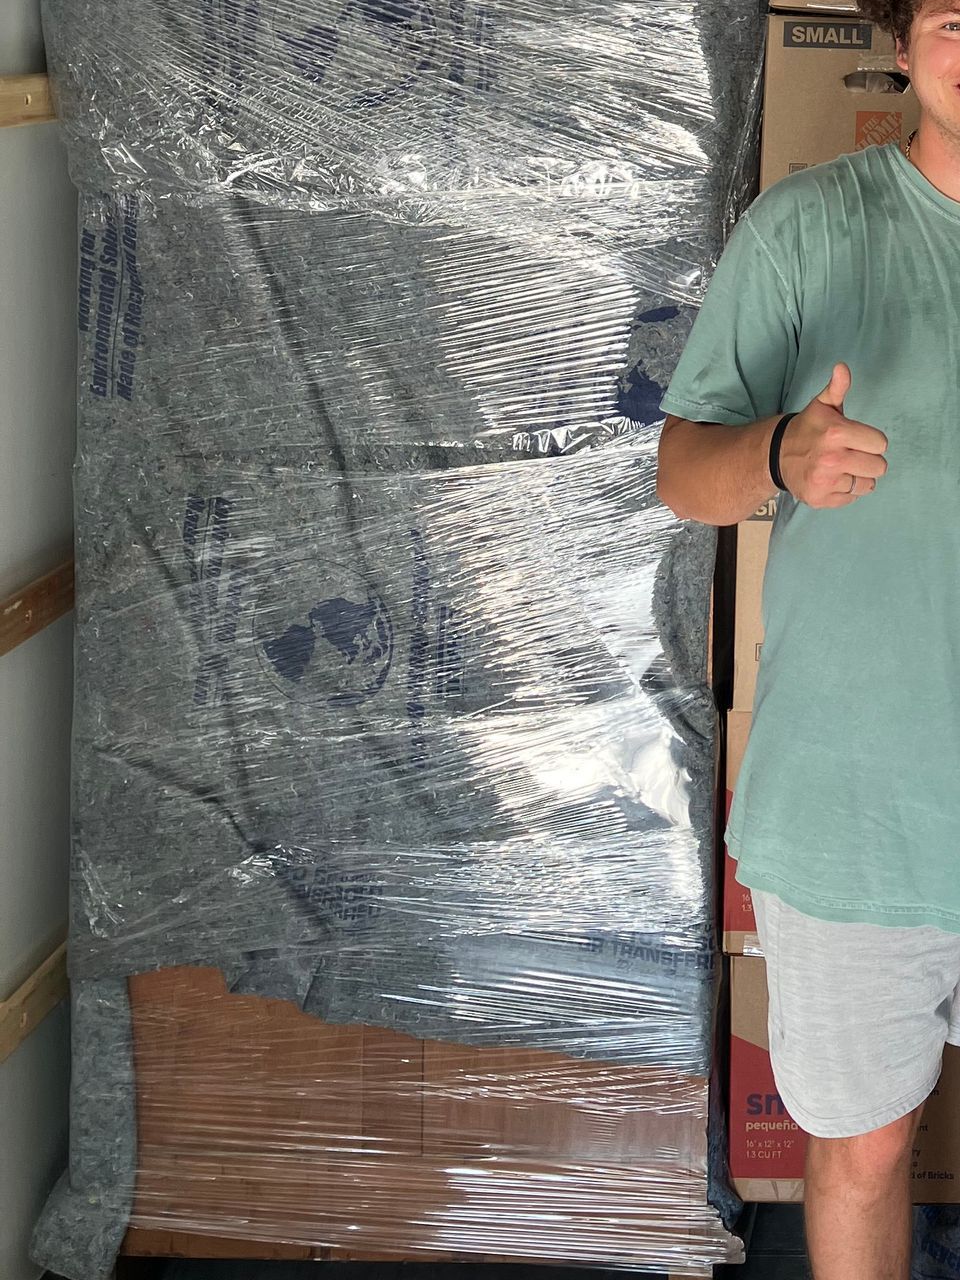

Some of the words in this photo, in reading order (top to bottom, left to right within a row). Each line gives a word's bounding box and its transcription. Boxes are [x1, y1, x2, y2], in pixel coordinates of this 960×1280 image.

[792, 26, 864, 45] SMALL
[80, 227, 96, 256] for
[89, 267, 117, 398] Environmental
[121, 326, 138, 349] of
[116, 351, 137, 401] Made
[745, 1120, 798, 1133] pequeña
[758, 1151, 771, 1159] CU
[772, 1151, 782, 1159] FT
[917, 1170, 926, 1179] of
[927, 1170, 955, 1180] Bricks
